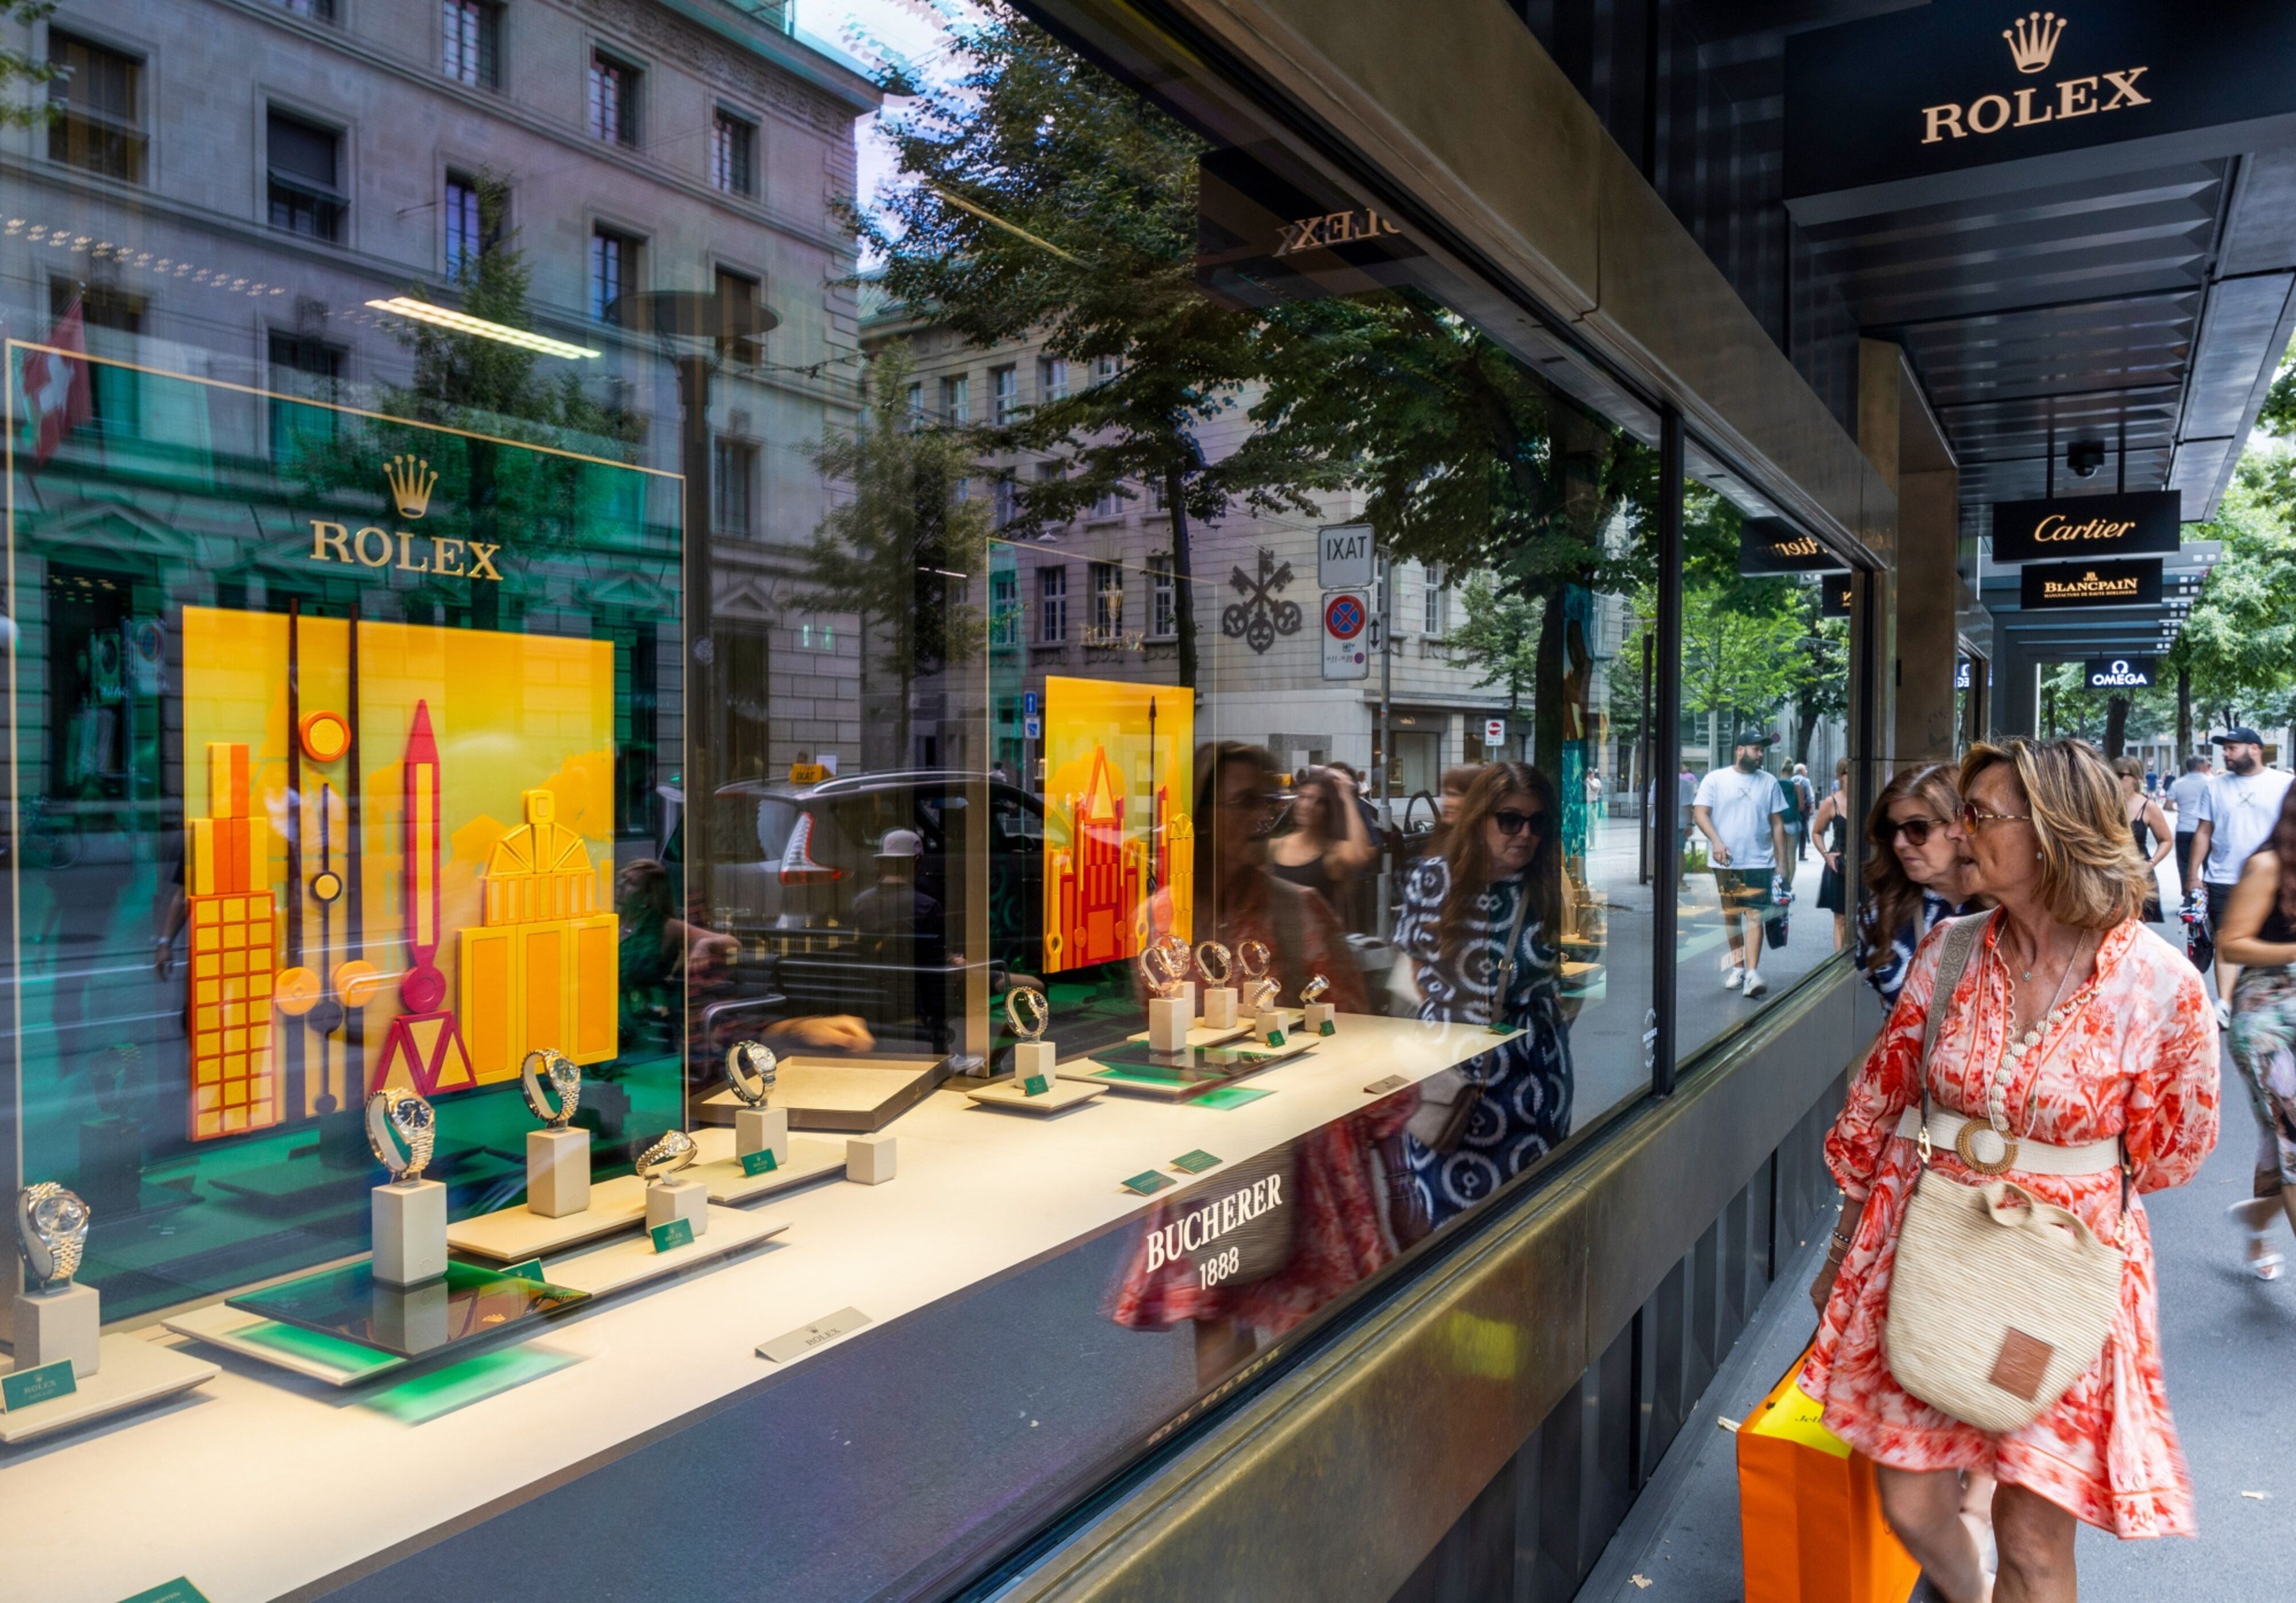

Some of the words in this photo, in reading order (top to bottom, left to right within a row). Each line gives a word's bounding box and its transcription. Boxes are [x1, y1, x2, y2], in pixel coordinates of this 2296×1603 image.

[1921, 67, 2151, 144] ROLEX
[2034, 514, 2136, 543] Cartier
[309, 520, 503, 581] ROLEX
[2044, 578, 2138, 593] BLANCPAIN
[2092, 673, 2147, 686] OMEGA
[1146, 1173, 1283, 1273] BUCHERER
[1200, 1246, 1239, 1290] 1888
[805, 1328, 841, 1346] ROLEX
